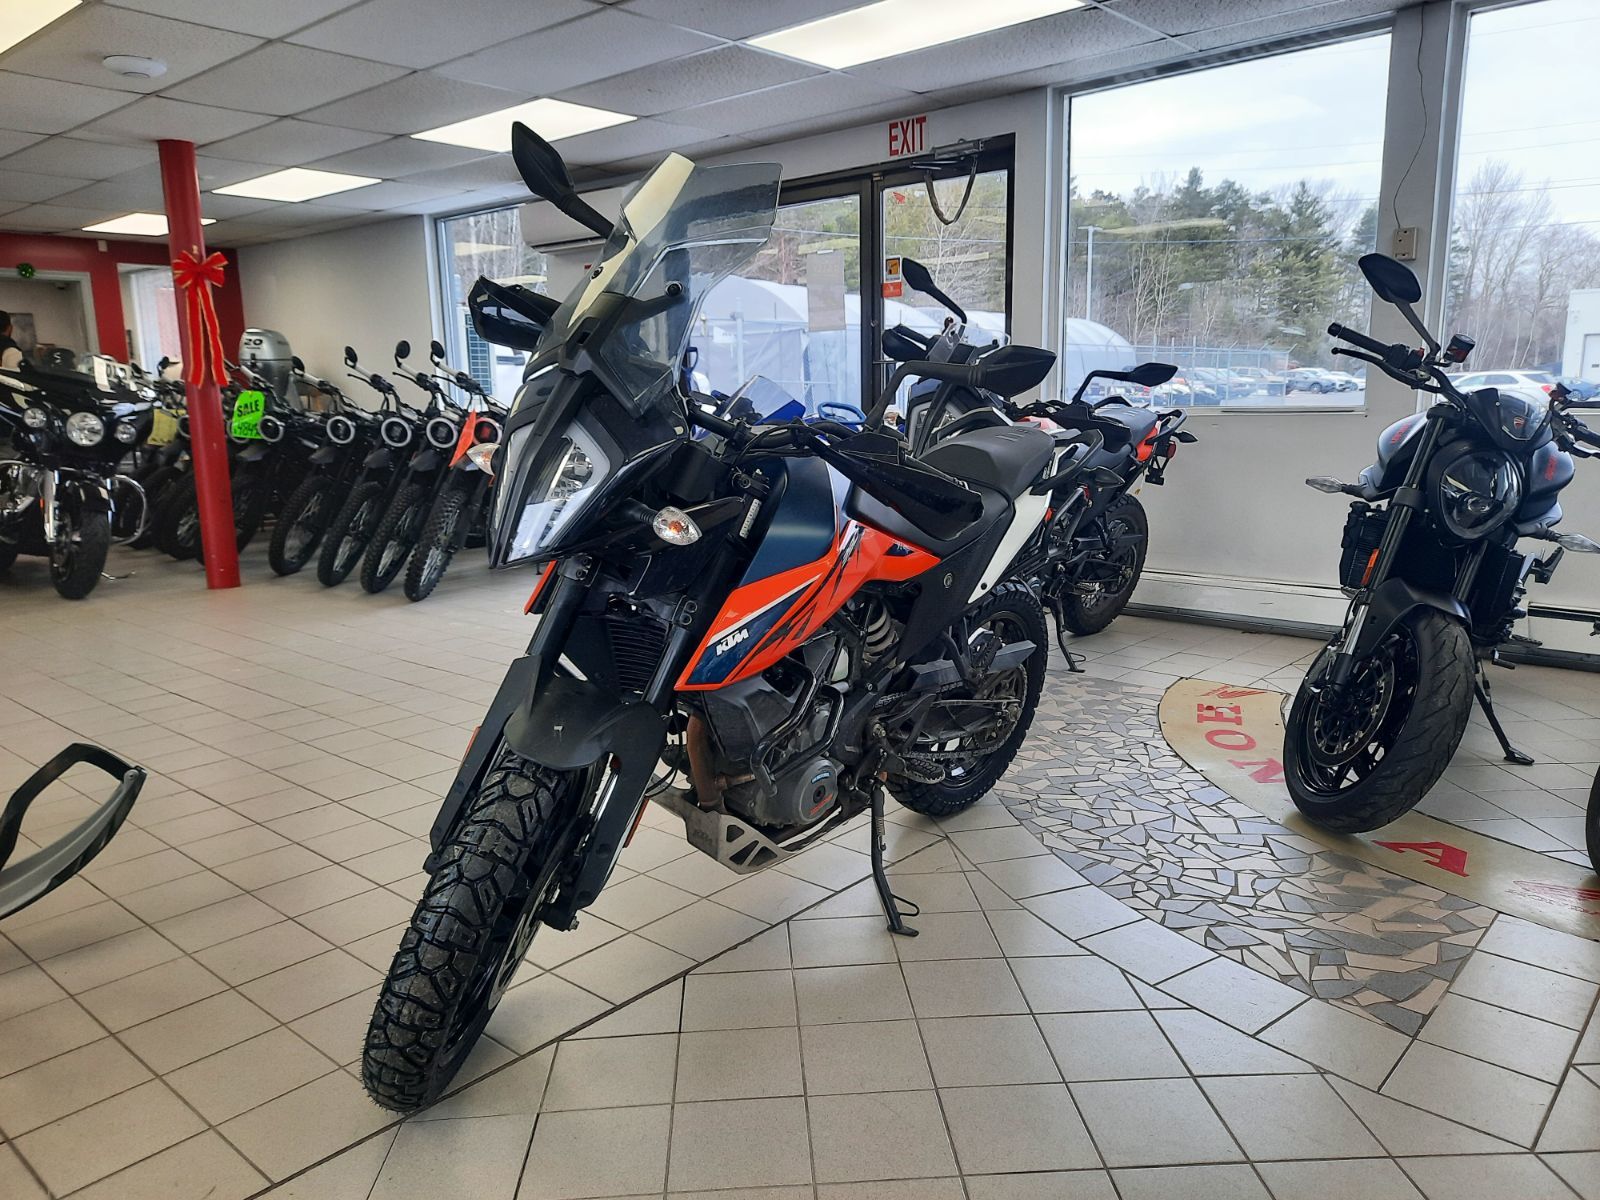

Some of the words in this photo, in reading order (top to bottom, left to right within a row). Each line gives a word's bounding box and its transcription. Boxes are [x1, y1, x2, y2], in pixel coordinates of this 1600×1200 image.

[889, 115, 927, 156] EXIT
[244, 338, 263, 346] 20
[237, 399, 261, 417] SALE
[716, 628, 750, 656] KTM
